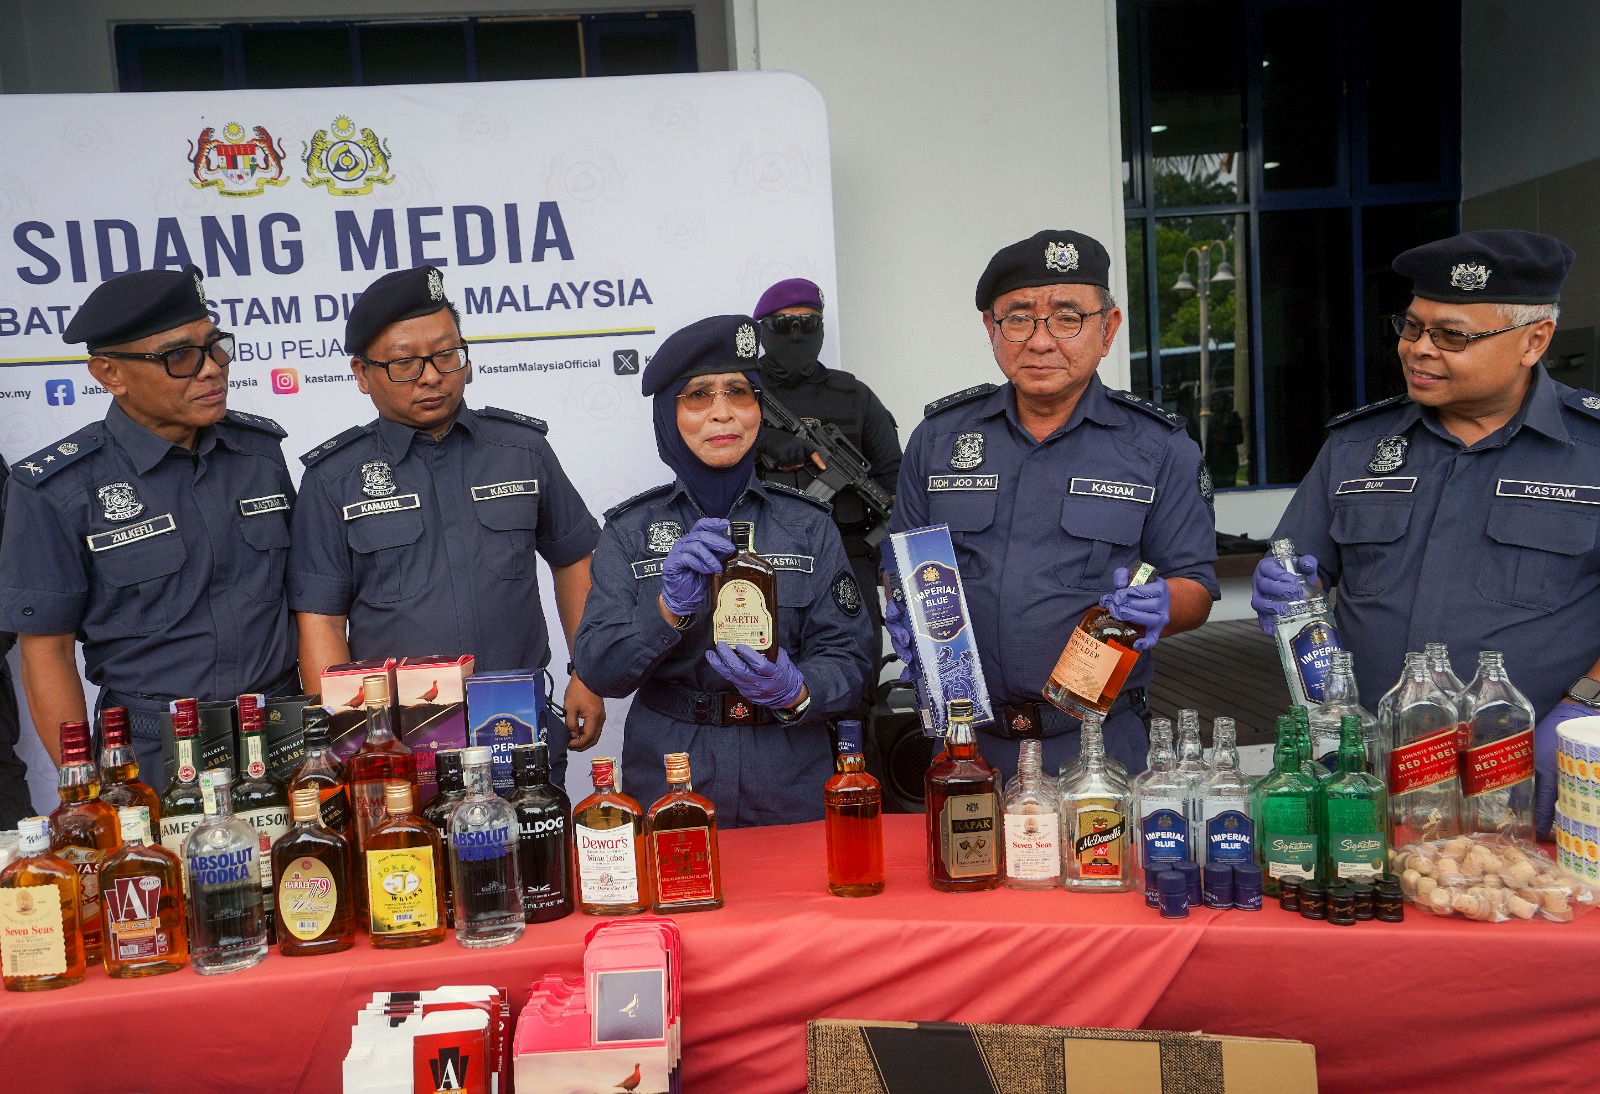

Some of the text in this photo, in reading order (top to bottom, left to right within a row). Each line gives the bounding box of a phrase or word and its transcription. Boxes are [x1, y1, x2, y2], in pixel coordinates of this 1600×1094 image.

[13, 201, 575, 285] SIDANG MEDIA
[207, 295, 303, 327] STAM
[464, 278, 653, 315] MALAYSIA
[281, 338, 345, 360] PEJA
[478, 358, 601, 375] KastamMalaysiaOfficial
[304, 373, 357, 384] kastam.m
[490, 483, 525, 496] KASTAM
[932, 477, 994, 489] KOH JOO KAI
[1091, 482, 1135, 498] KASTAM
[1364, 480, 1384, 490] BUN
[1524, 484, 1577, 499] KASTAM
[360, 498, 402, 514] KAMARUL
[111, 522, 154, 545] ZULKEFLI
[914, 585, 957, 603] IMPERIAL
[925, 595, 949, 608] BLUE
[725, 615, 760, 624] MARTIN
[205, 753, 232, 769] ABEL
[281, 748, 305, 764] LABE
[492, 755, 512, 764] BLU
[1397, 747, 1457, 772] RED LABEL
[1401, 749, 1428, 762] JOHNNIE
[1474, 746, 1533, 772] RED LABEL
[1477, 749, 1504, 762] JOHNNIE
[324, 808, 343, 823] ABEL
[519, 816, 563, 834] LLDOG
[955, 819, 991, 831] KAPAK
[453, 825, 509, 847] ABSOLUT
[581, 835, 628, 850] Dewar's
[1079, 825, 1121, 851] McDowell's
[1145, 831, 1185, 843] IMPERIAL
[1210, 833, 1251, 844] IMPERIAL
[1012, 841, 1053, 849] Seven Seas
[1154, 840, 1176, 848] BLUE
[1220, 842, 1242, 850] BLUE
[1271, 838, 1314, 853] Signature
[1339, 838, 1382, 853] Signature
[191, 846, 253, 871] ABSOLUT
[456, 842, 507, 862] VODKA
[196, 863, 250, 887] VODKA
[377, 863, 416, 878] JOKER
[285, 877, 331, 898] BARREL 79
[391, 887, 423, 902] Whisky
[116, 879, 151, 921] A
[5, 925, 55, 937] Seven Seas
[118, 921, 153, 931] CLASS
[437, 1058, 462, 1092] A
